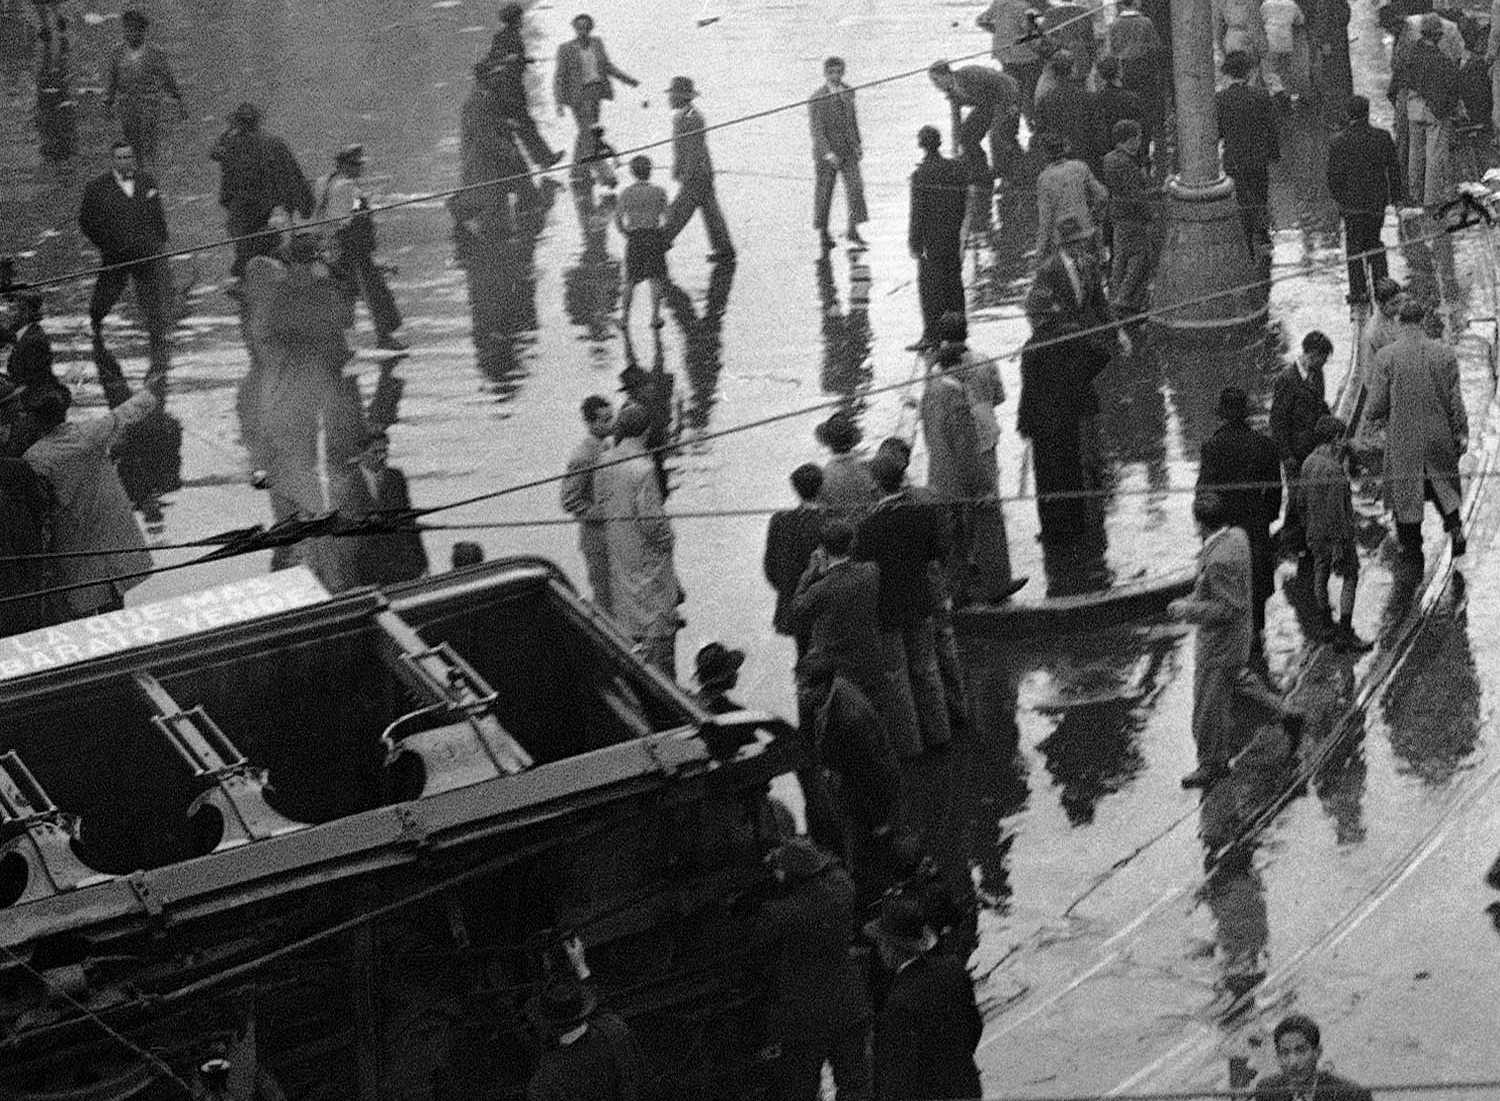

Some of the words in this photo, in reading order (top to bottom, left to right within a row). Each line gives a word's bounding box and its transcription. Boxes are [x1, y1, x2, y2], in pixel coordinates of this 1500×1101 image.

[0, 625, 160, 677] BARATO
[12, 627, 70, 654] LA
[85, 603, 171, 634] QUE
